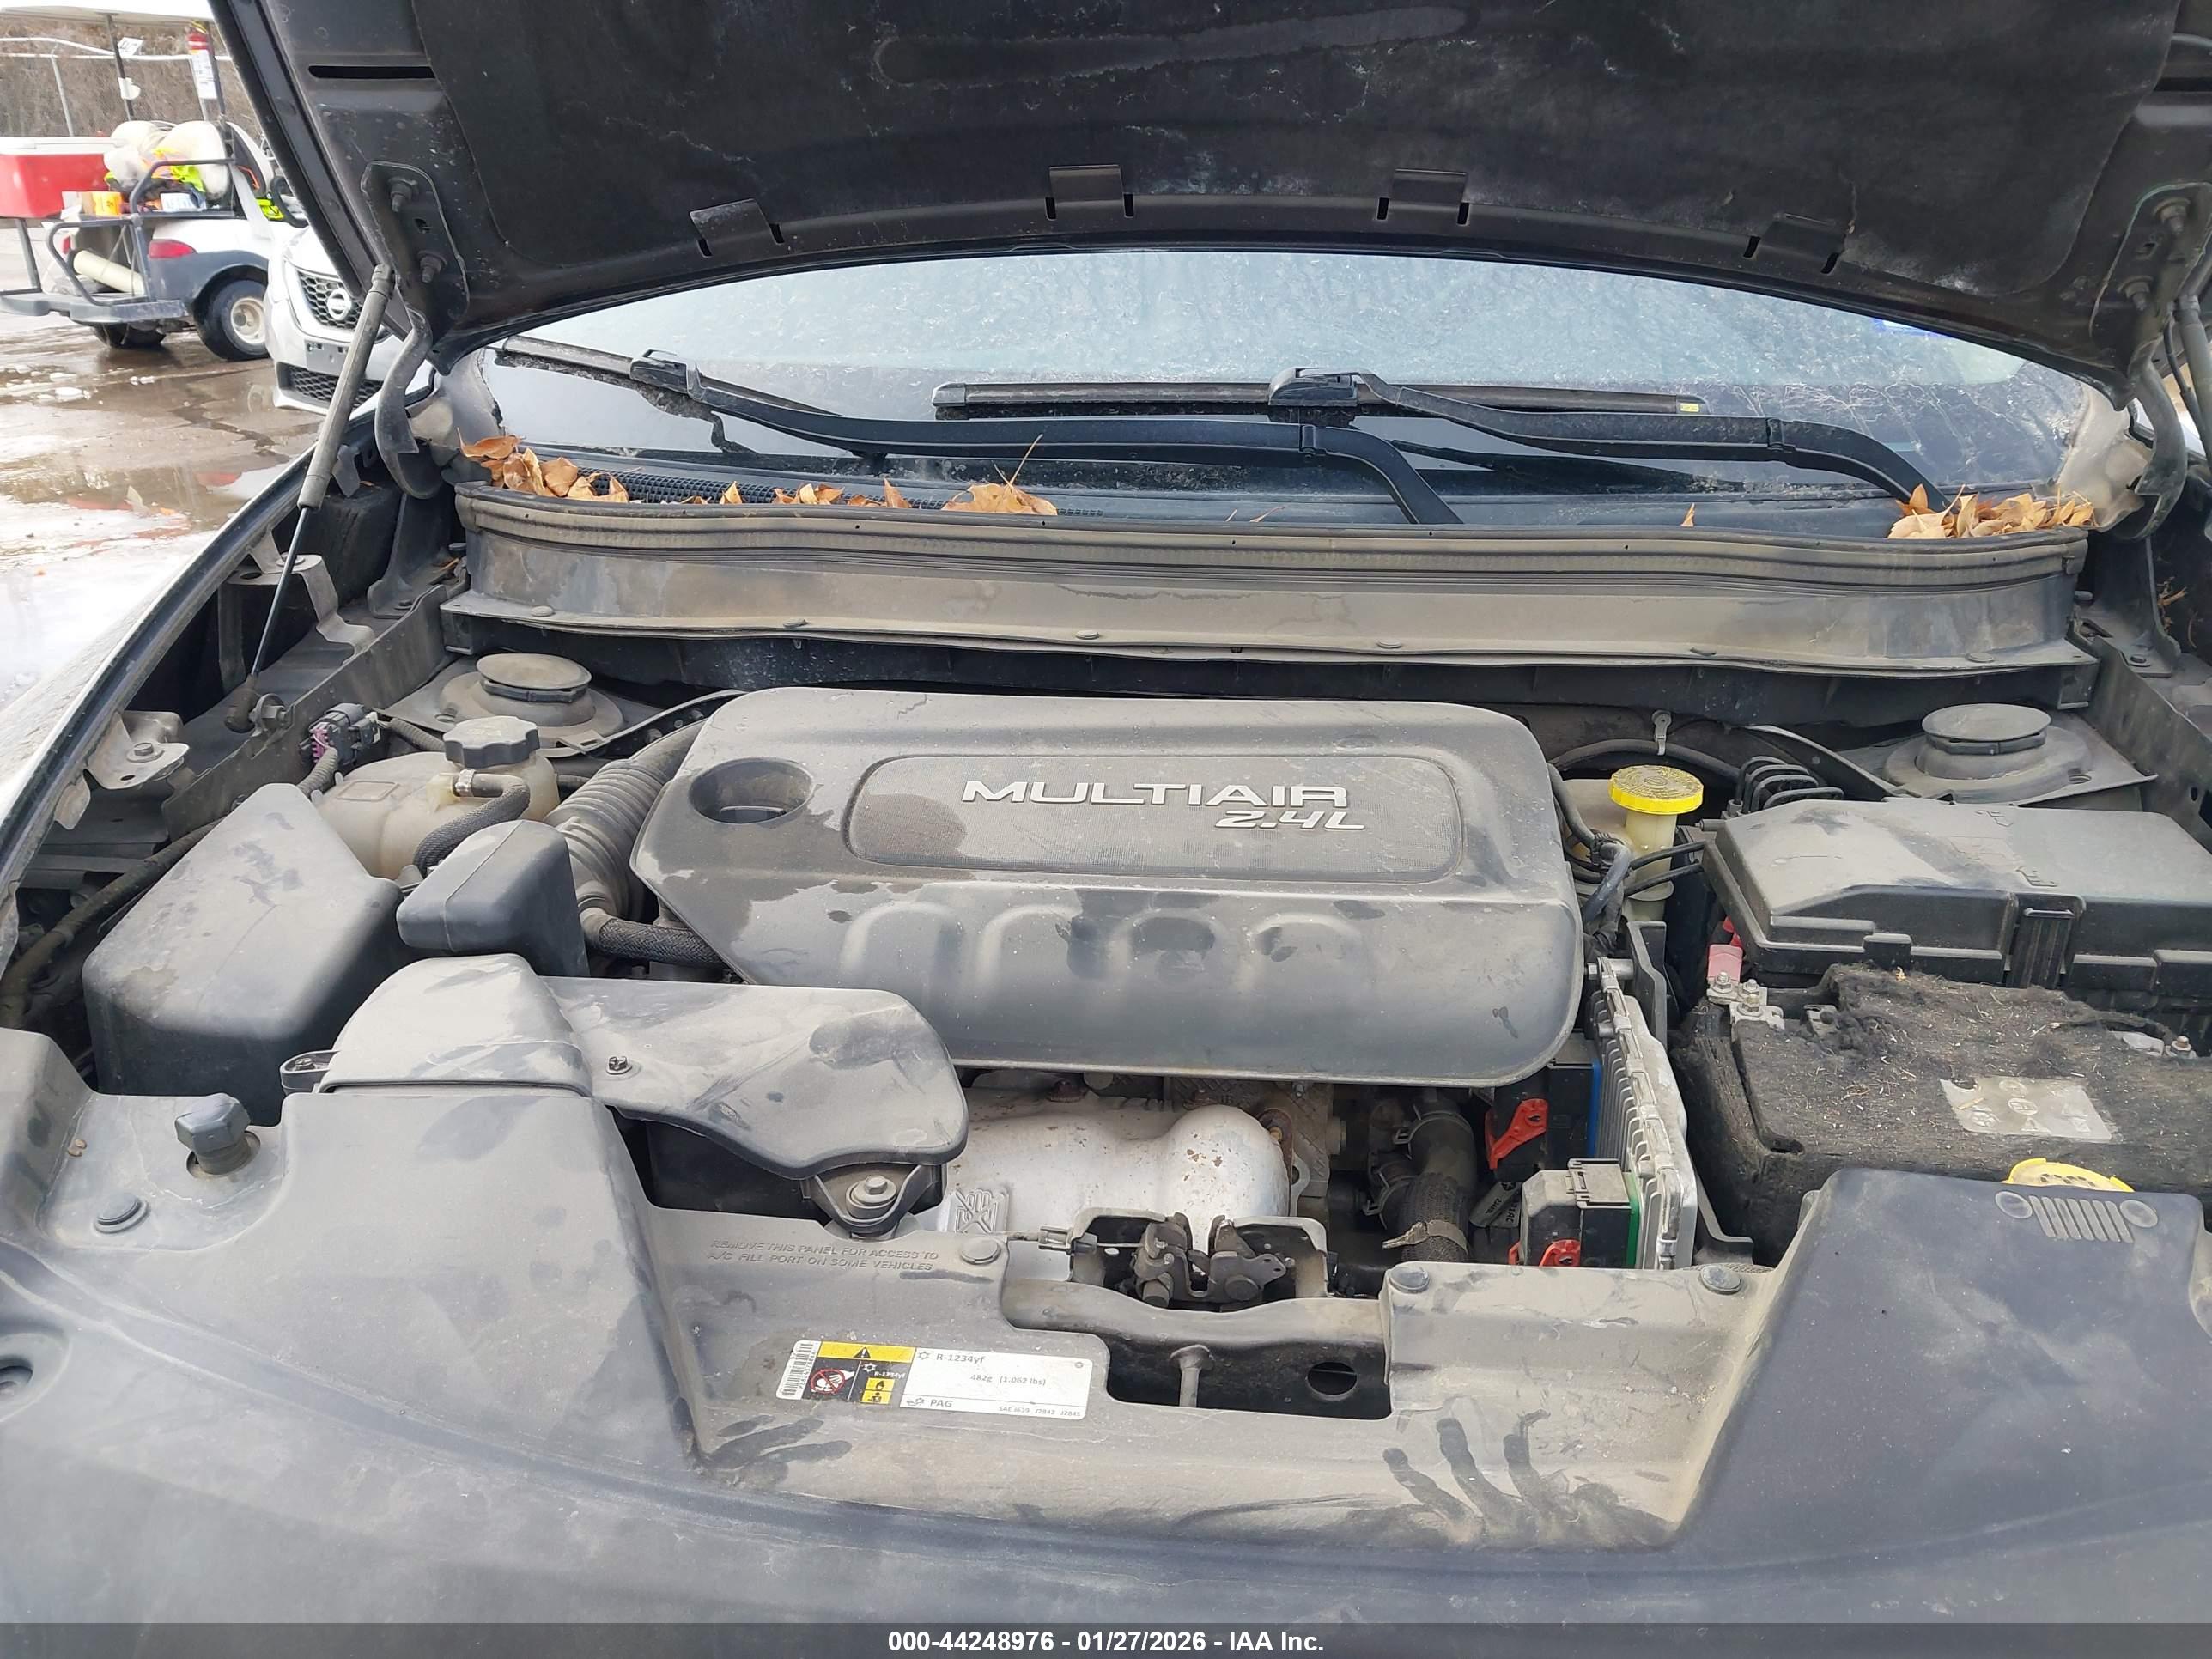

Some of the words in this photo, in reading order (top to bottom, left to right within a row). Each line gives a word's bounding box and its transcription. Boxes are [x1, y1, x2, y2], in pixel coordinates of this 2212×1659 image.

[961, 780, 1349, 808] MULTIAIR
[1215, 810, 1367, 830] 2.4L
[711, 1239, 765, 1251] REMOVE
[767, 1243, 796, 1253] THIS
[797, 1245, 838, 1256] PANEL
[841, 1248, 869, 1257] FOR
[870, 1250, 921, 1260] ACCESS
[922, 1252, 939, 1261] TO
[738, 1254, 764, 1263] FILL
[769, 1255, 805, 1267] PORT
[807, 1257, 828, 1267] ON
[830, 1258, 868, 1270] SOME
[872, 1261, 934, 1272] VEHICLES
[936, 1352, 986, 1365] R-1234yf
[970, 1374, 993, 1383] 482g
[999, 1375, 1028, 1384] (1.062
[1030, 1377, 1046, 1386] lbs)
[930, 1398, 953, 1409] PAG
